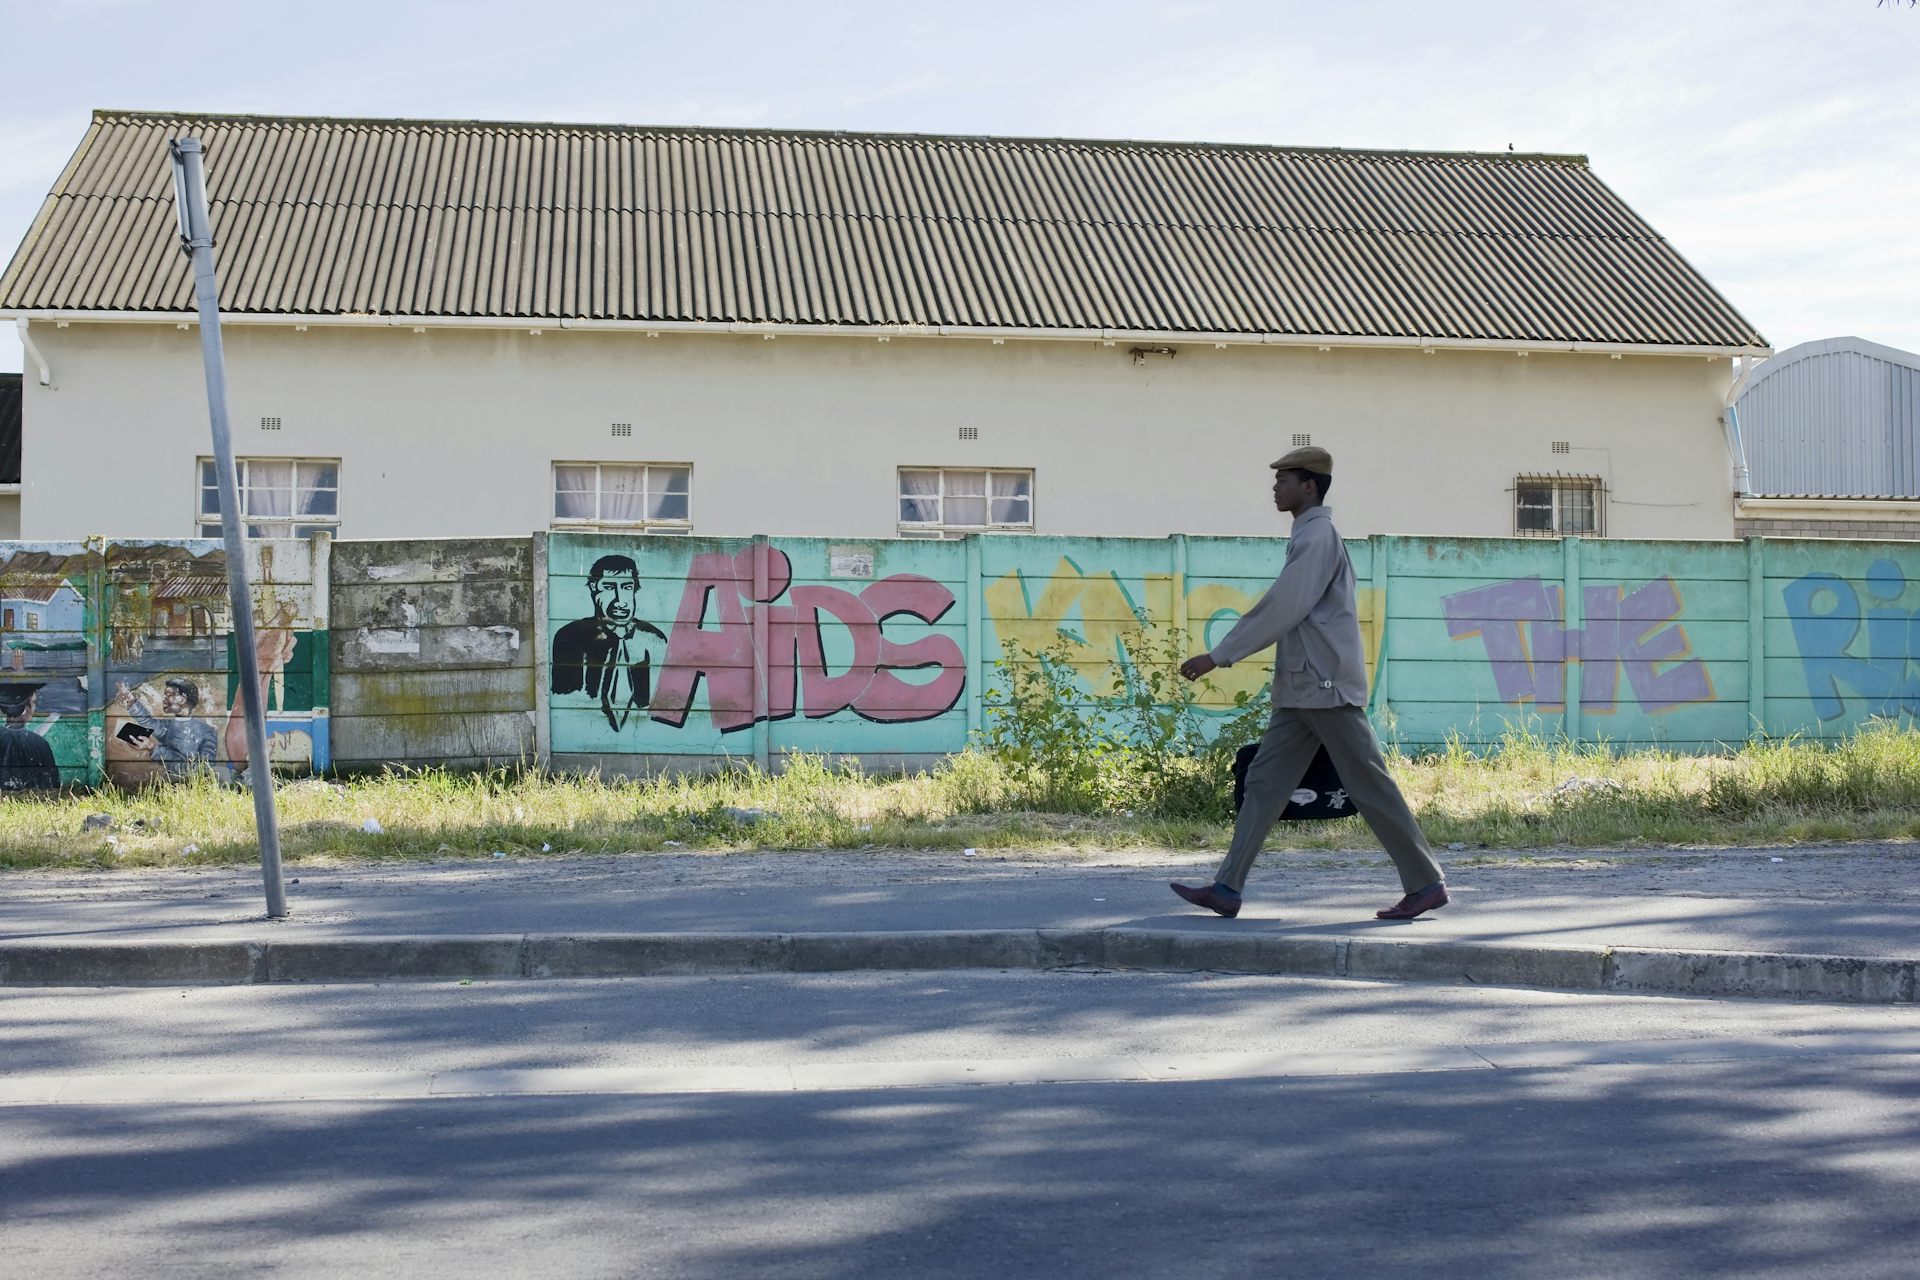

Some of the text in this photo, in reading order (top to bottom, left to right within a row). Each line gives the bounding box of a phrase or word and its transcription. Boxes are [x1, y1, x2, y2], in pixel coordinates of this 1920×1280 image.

[984, 555, 1387, 716] KNO
[1440, 574, 1717, 715] THE
[1782, 558, 1920, 722] Ri
